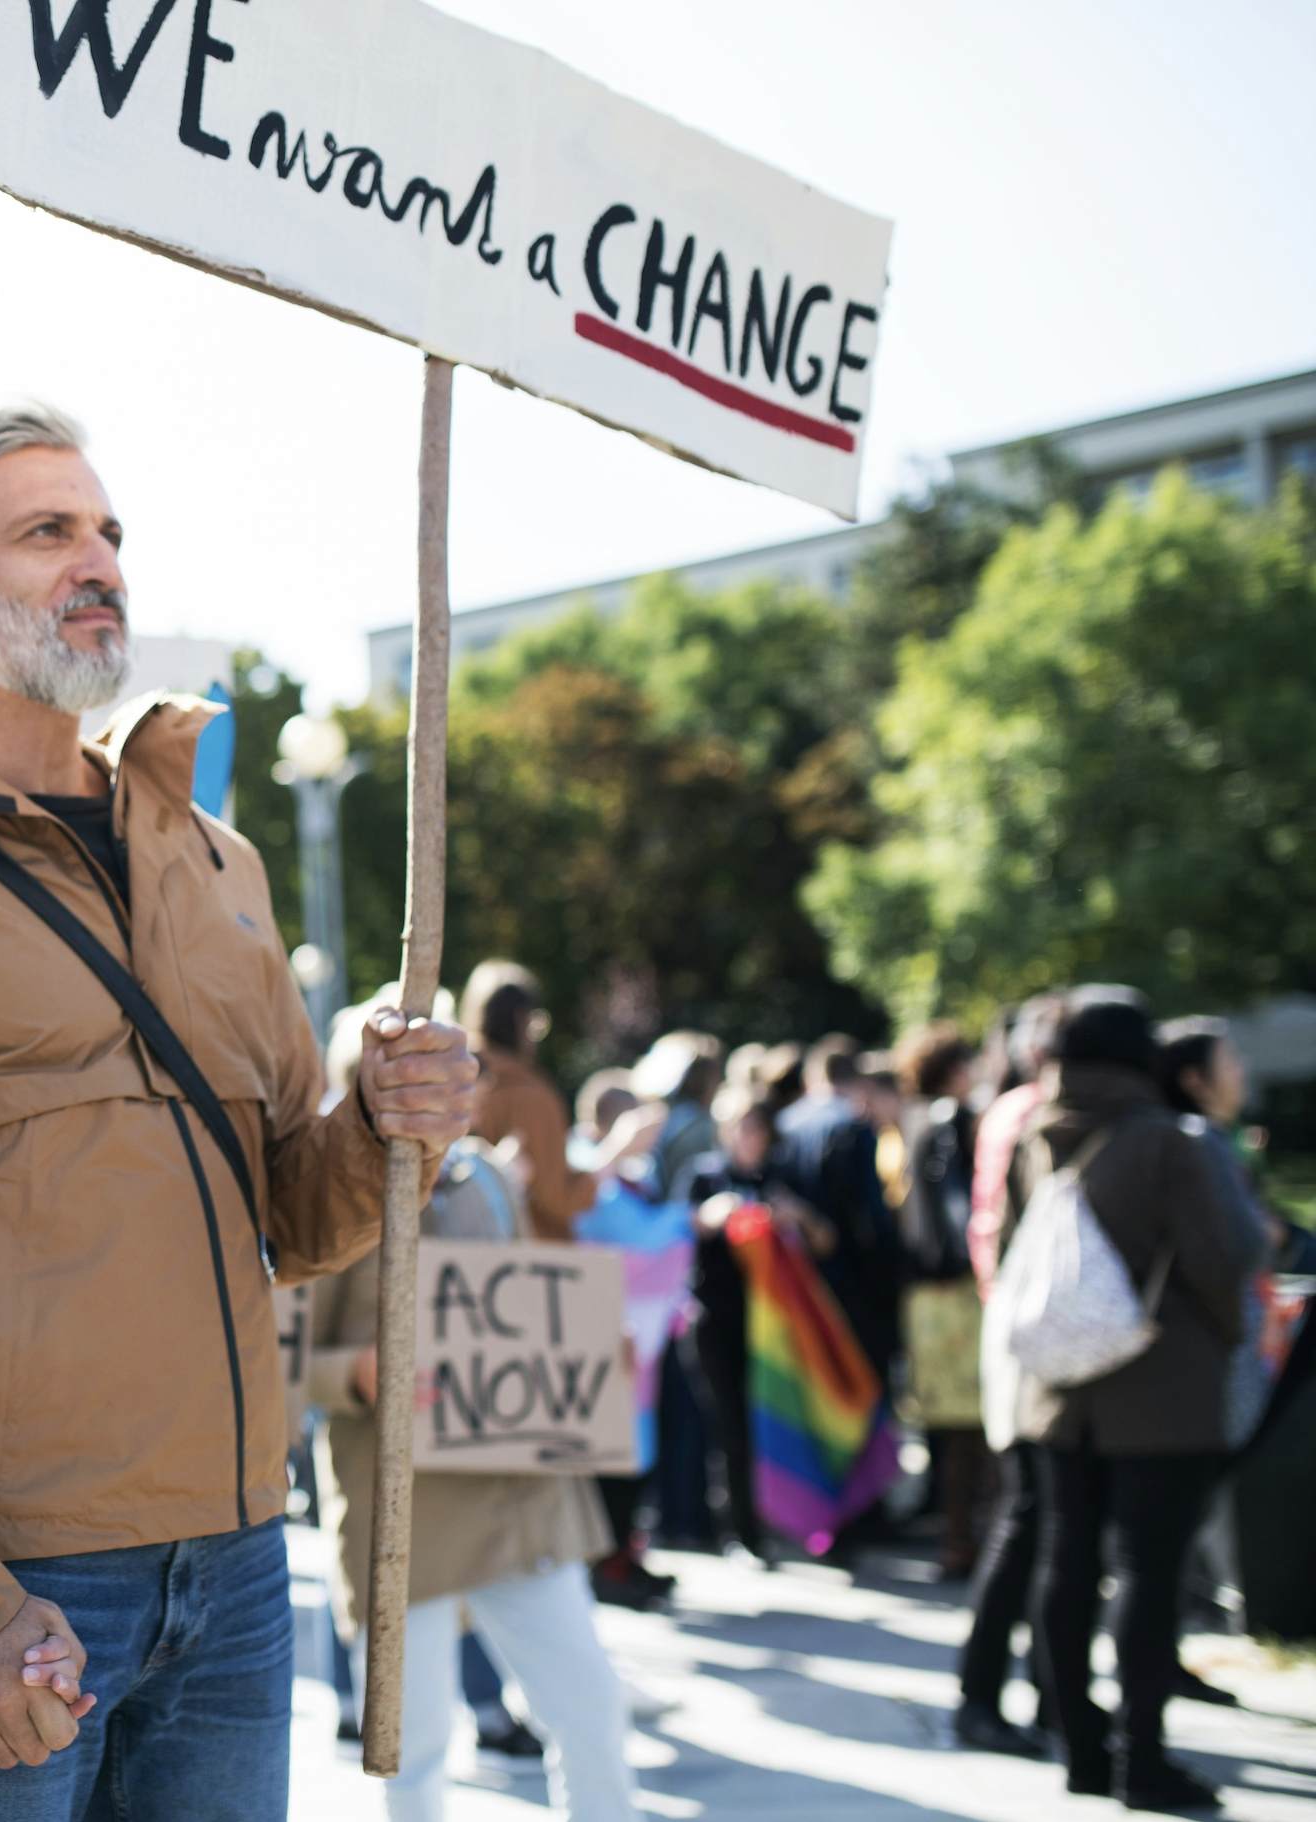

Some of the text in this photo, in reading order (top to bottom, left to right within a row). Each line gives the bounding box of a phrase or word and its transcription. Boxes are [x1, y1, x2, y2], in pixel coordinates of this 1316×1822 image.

[29, 0, 879, 424] WE want a CHANGE
[432, 1259, 581, 1347] ACT
[432, 1350, 612, 1438] NOW
